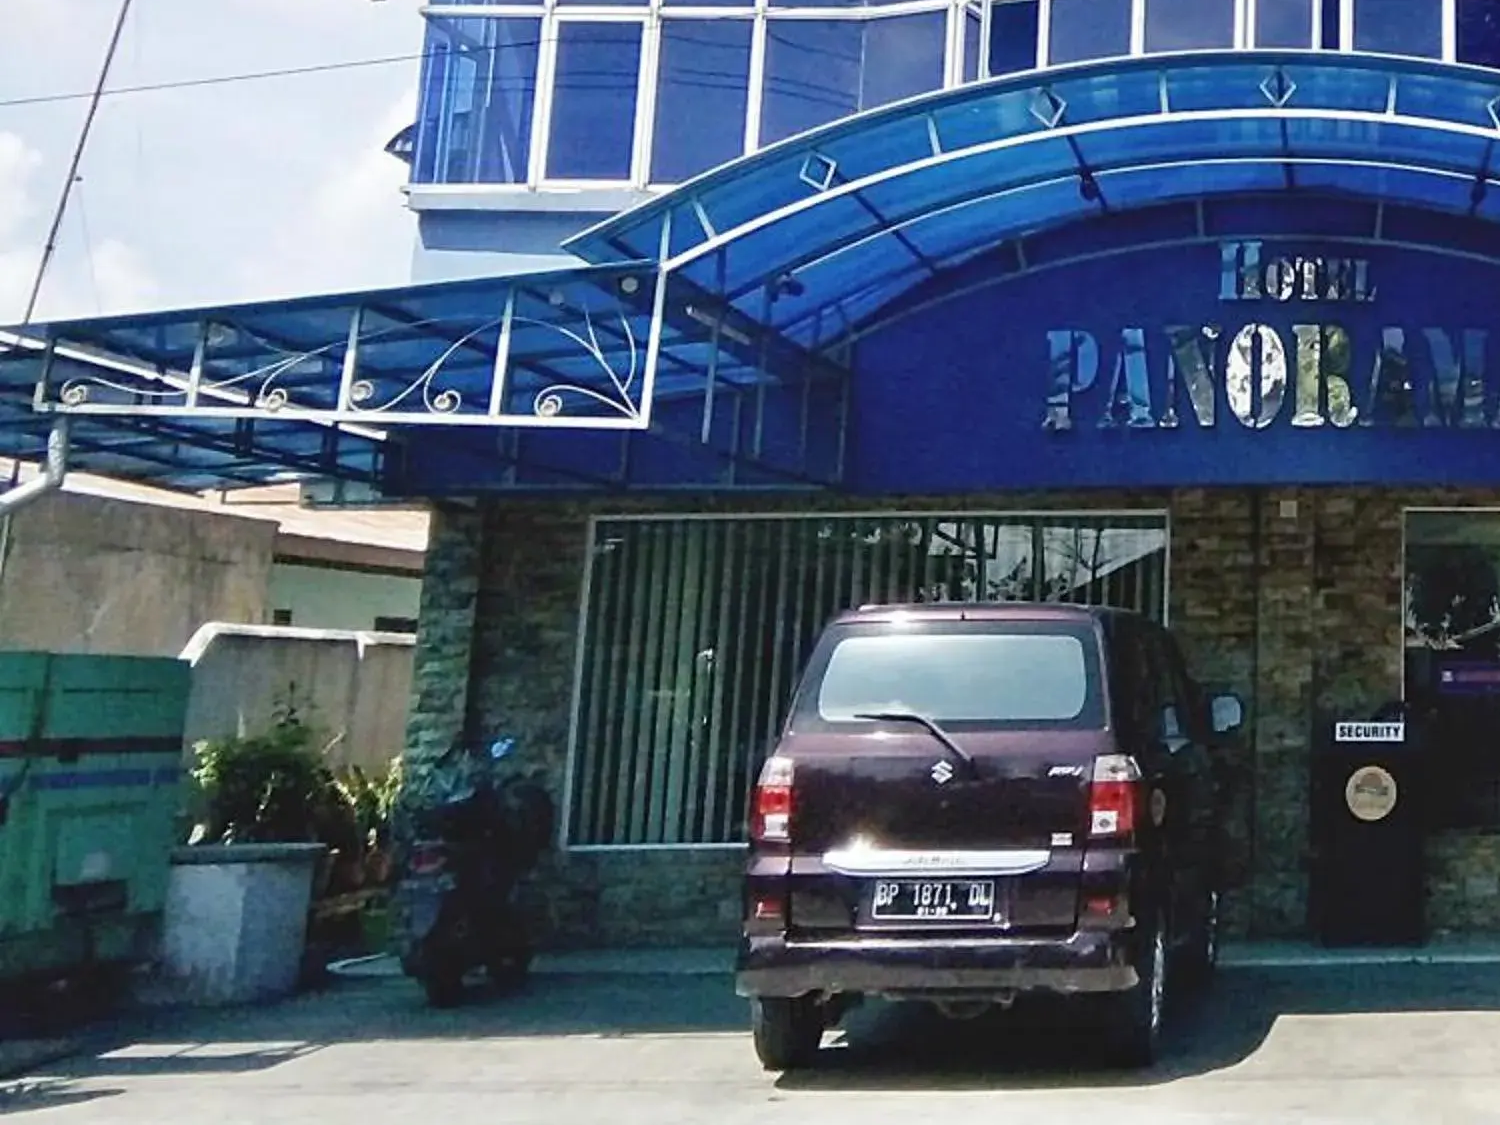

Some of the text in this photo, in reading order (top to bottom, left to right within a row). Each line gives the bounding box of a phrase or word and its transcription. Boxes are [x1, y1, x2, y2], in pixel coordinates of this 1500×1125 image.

[1217, 240, 1377, 302] HOTEL
[1339, 725, 1401, 738] SECURITY
[876, 883, 899, 906] BP
[913, 883, 952, 906] 1871
